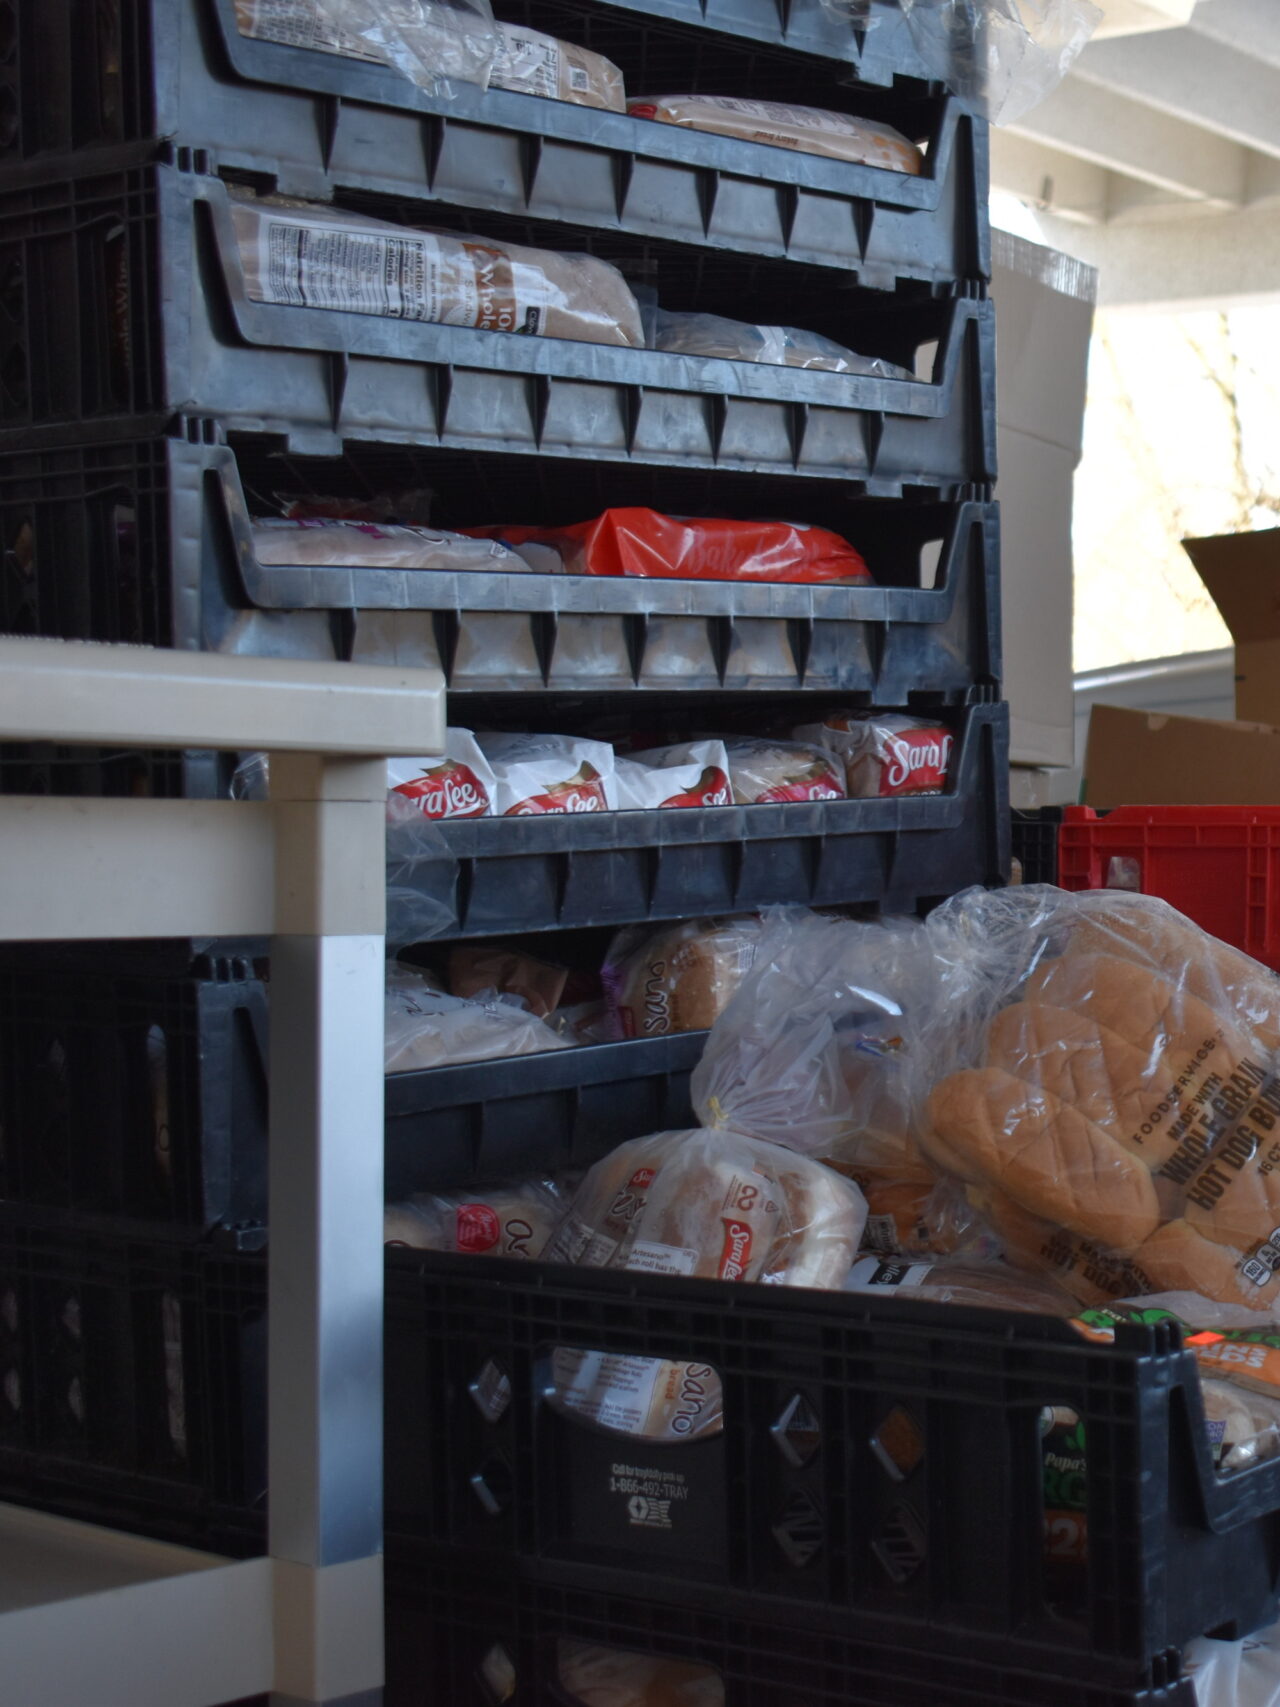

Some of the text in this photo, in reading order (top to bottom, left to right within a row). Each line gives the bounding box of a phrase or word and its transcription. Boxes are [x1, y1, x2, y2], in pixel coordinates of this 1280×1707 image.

[387, 238, 395, 287] Calories
[415, 242, 426, 298] Nutrition
[480, 263, 497, 330] Whole
[888, 740, 941, 786] Sara
[643, 961, 671, 1034] sano
[1159, 1057, 1269, 1186] WHOLE GRAIN
[1166, 1071, 1224, 1142] MADE WITH
[1186, 1163, 1233, 1211] HOT
[1218, 1124, 1265, 1171] DOG
[1257, 1160, 1275, 1177] 16
[728, 1223, 750, 1261] Sara
[876, 1264, 900, 1285] lley
[664, 1369, 681, 1400] bread
[671, 1362, 711, 1435] sano
[610, 1476, 689, 1500] 1-866-492-TRAY
